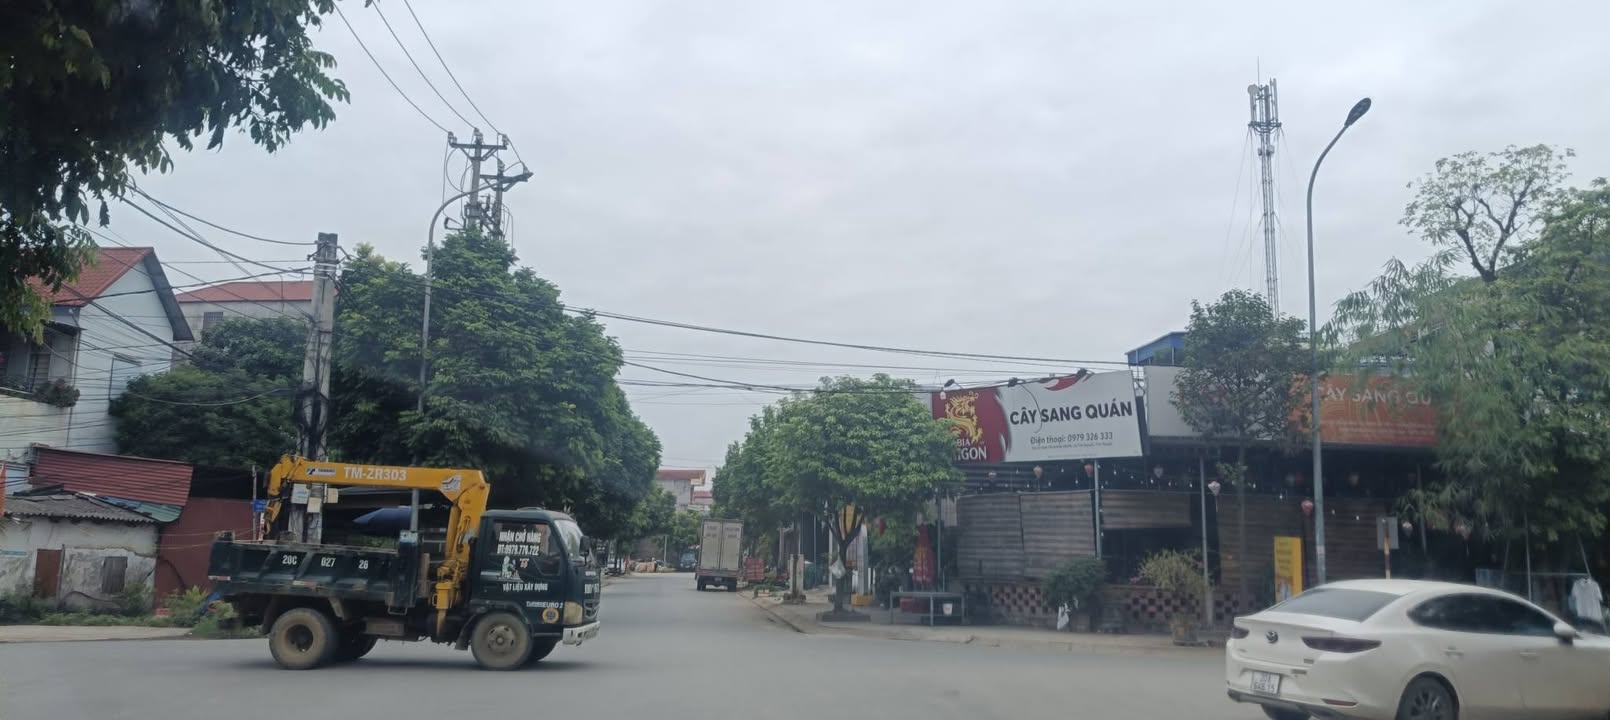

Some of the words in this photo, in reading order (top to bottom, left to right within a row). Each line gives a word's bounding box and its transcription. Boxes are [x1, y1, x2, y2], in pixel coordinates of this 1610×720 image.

[1010, 407, 1037, 425] CÂY
[1040, 406, 1081, 422] SANG
[1085, 398, 1133, 419] QUÁN
[957, 438, 970, 447] BIA
[1067, 433, 1085, 442] 0979
[344, 466, 407, 481] TM-ZR303
[282, 555, 297, 565] 20C
[321, 557, 336, 567] 027
